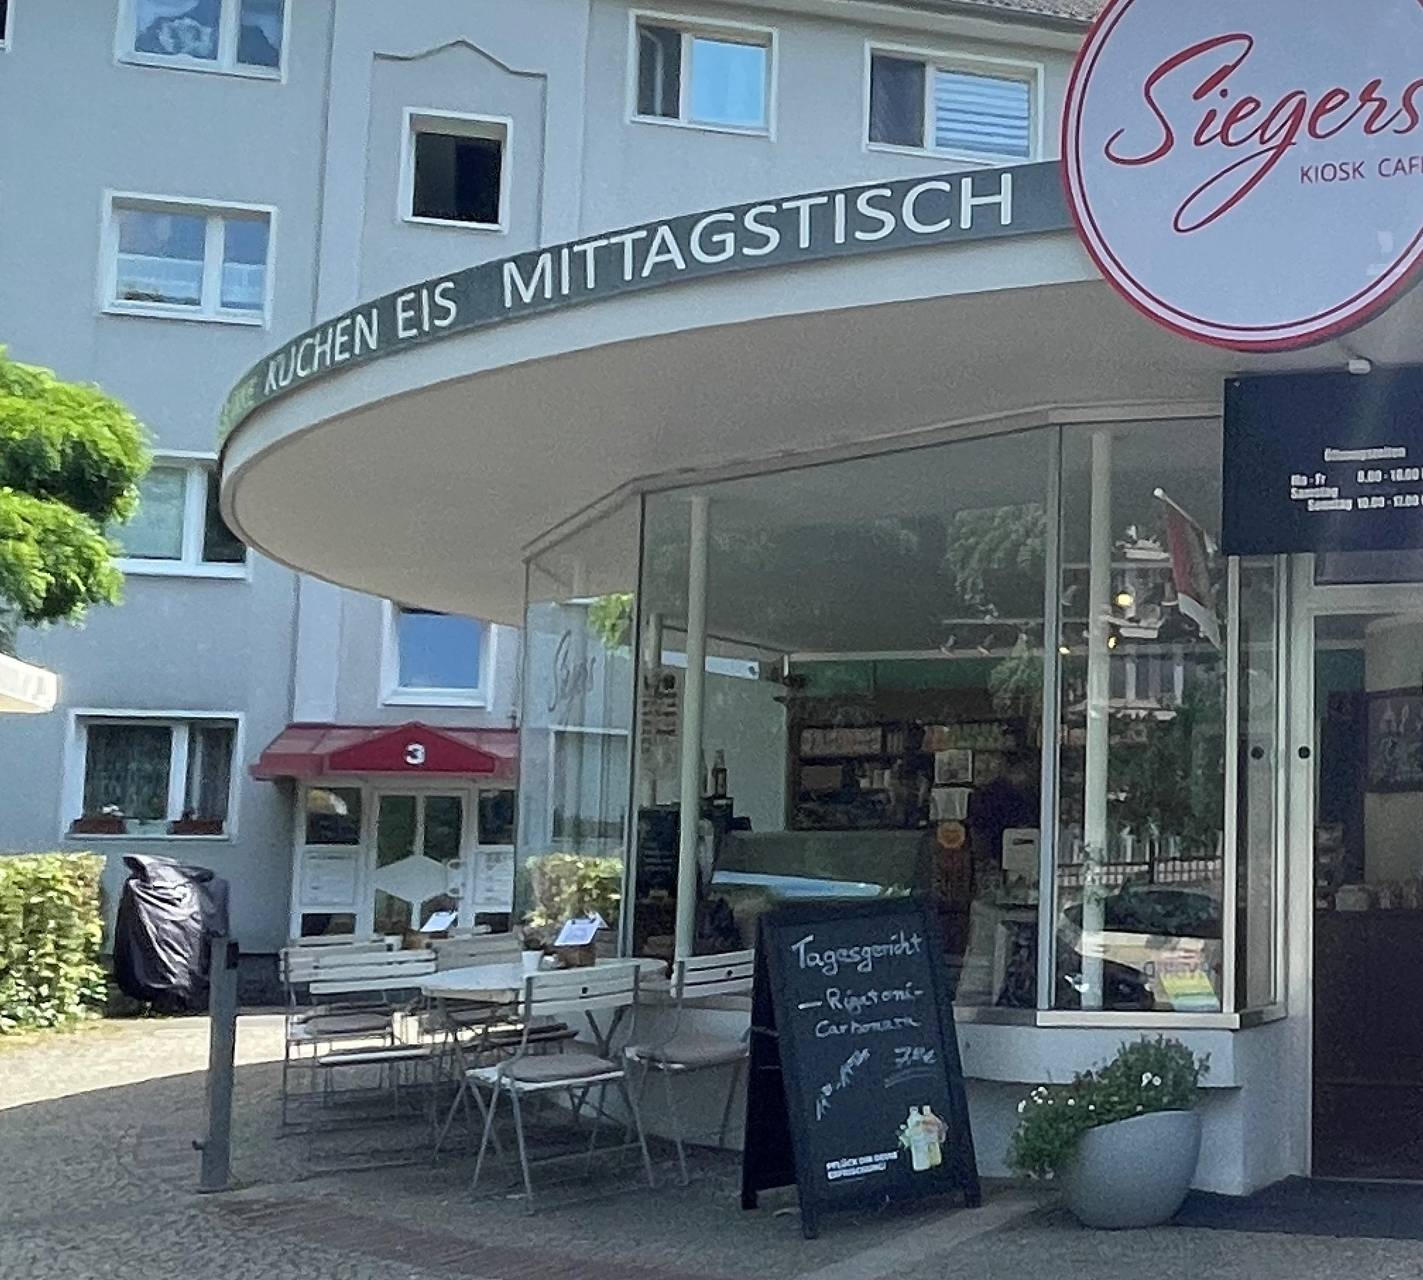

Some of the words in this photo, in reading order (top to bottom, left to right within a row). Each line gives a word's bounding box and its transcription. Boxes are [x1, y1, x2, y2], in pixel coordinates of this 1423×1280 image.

[1300, 160, 1366, 184] KIOSK
[263, 308, 378, 396] KUCHEN
[395, 280, 457, 341] EIS
[501, 173, 1013, 310] MITTAGSTISCH
[1315, 472, 1327, 486] Fr
[404, 742, 426, 766] 3
[791, 930, 923, 976] Tagesgericht
